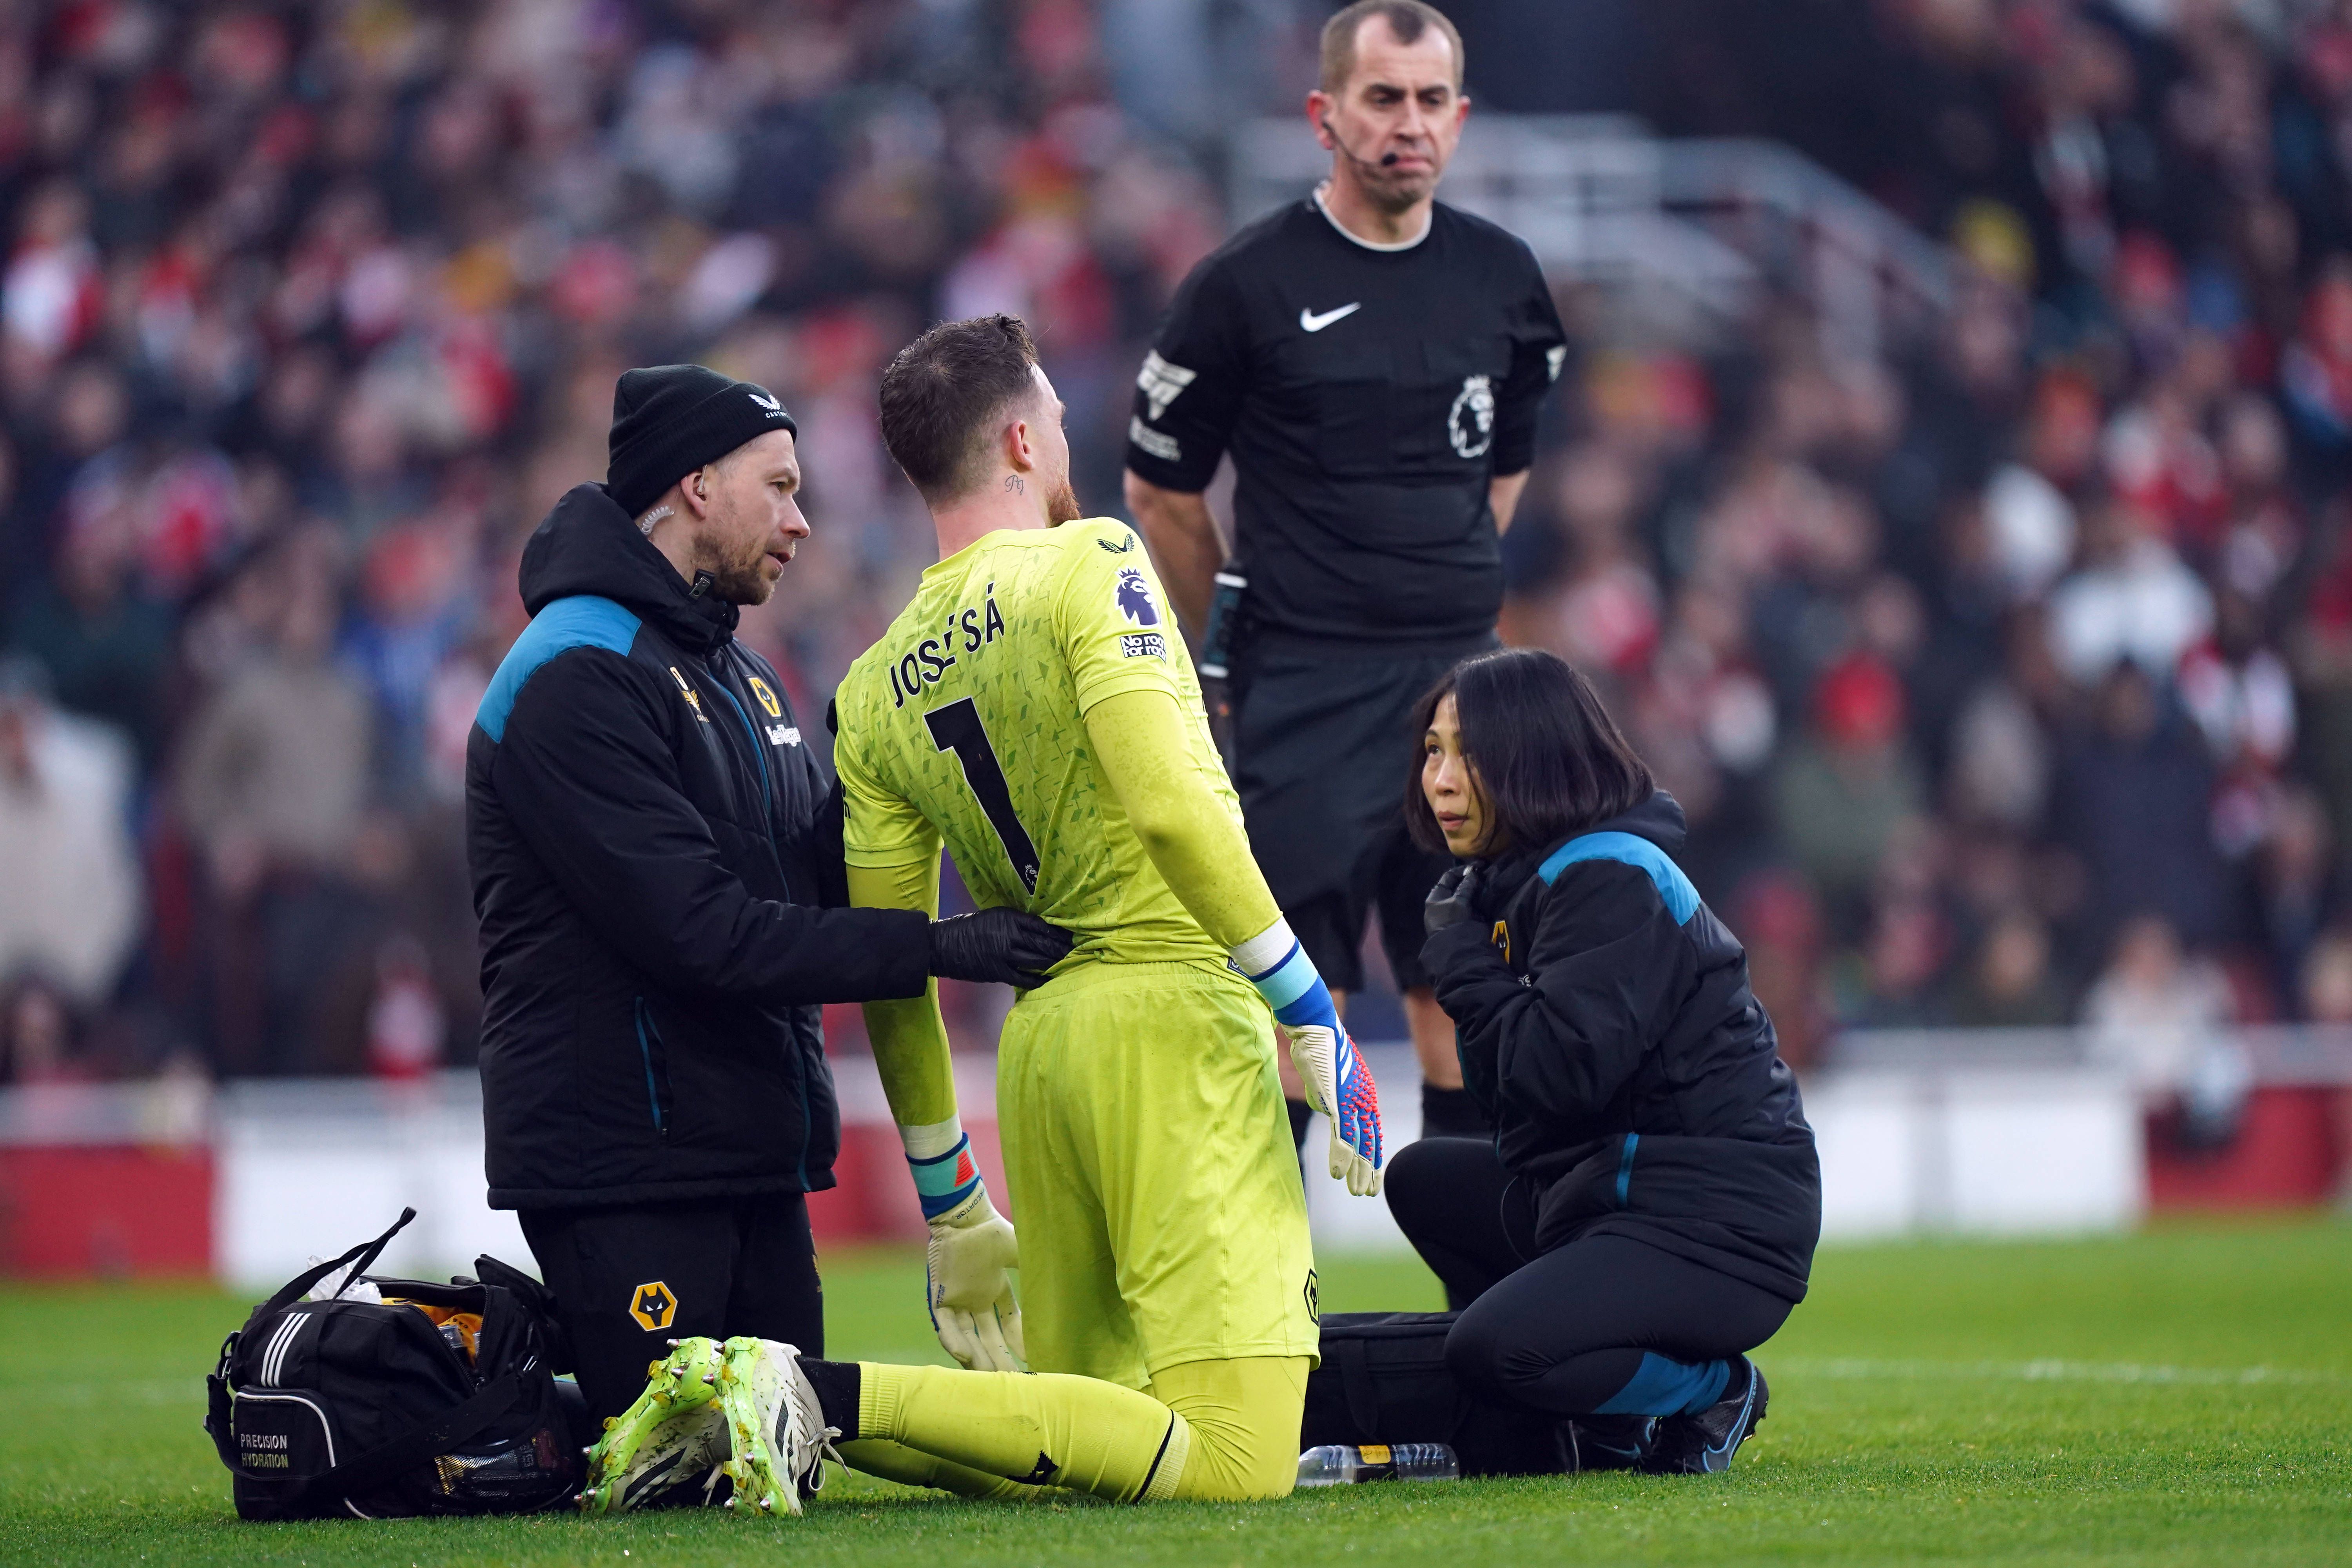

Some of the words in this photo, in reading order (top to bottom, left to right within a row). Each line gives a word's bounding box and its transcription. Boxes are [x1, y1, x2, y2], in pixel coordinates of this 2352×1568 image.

[961, 581, 1005, 653] SÁ
[1120, 636, 1142, 648] No
[923, 696, 1041, 897] 1
[240, 1434, 287, 1449] PRECISION
[241, 1452, 289, 1468] HYDRATION
